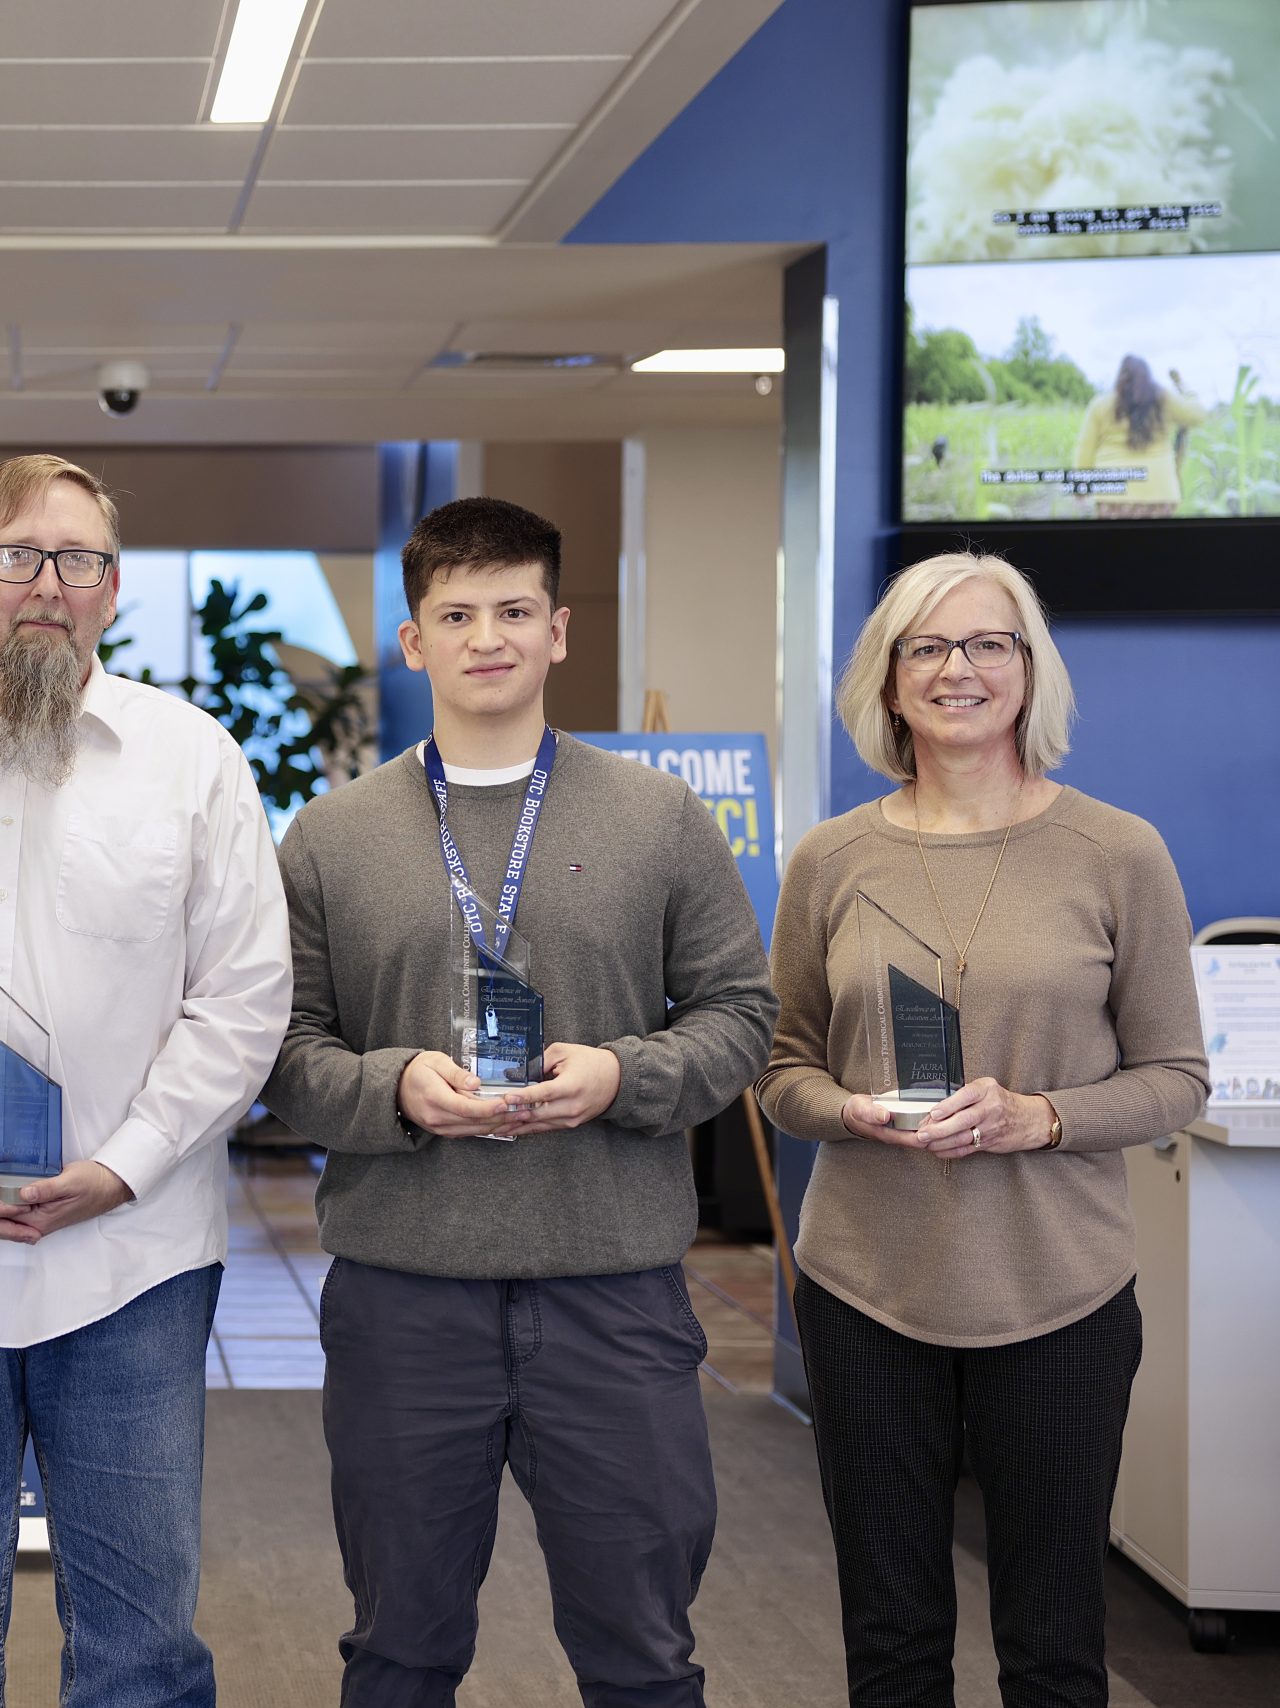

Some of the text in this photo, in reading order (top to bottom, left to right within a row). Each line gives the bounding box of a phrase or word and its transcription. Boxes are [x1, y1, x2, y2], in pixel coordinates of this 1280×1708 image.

[1055, 209, 1096, 224] going
[1102, 208, 1119, 220] to
[1125, 207, 1151, 221] get
[1158, 205, 1184, 217] the
[1056, 221, 1082, 233] the
[1086, 219, 1142, 234] platter
[528, 768, 548, 796] OTC
[506, 797, 541, 880] BOOKSTORE
[463, 902, 483, 934] OTC
[462, 949, 471, 996] COMMUNITY
[877, 968, 886, 1015] COMMUNITY
[879, 1016, 889, 1057] TECHNICAL
[911, 1070, 947, 1080] HARRIS
[912, 1061, 944, 1071] LAURA
